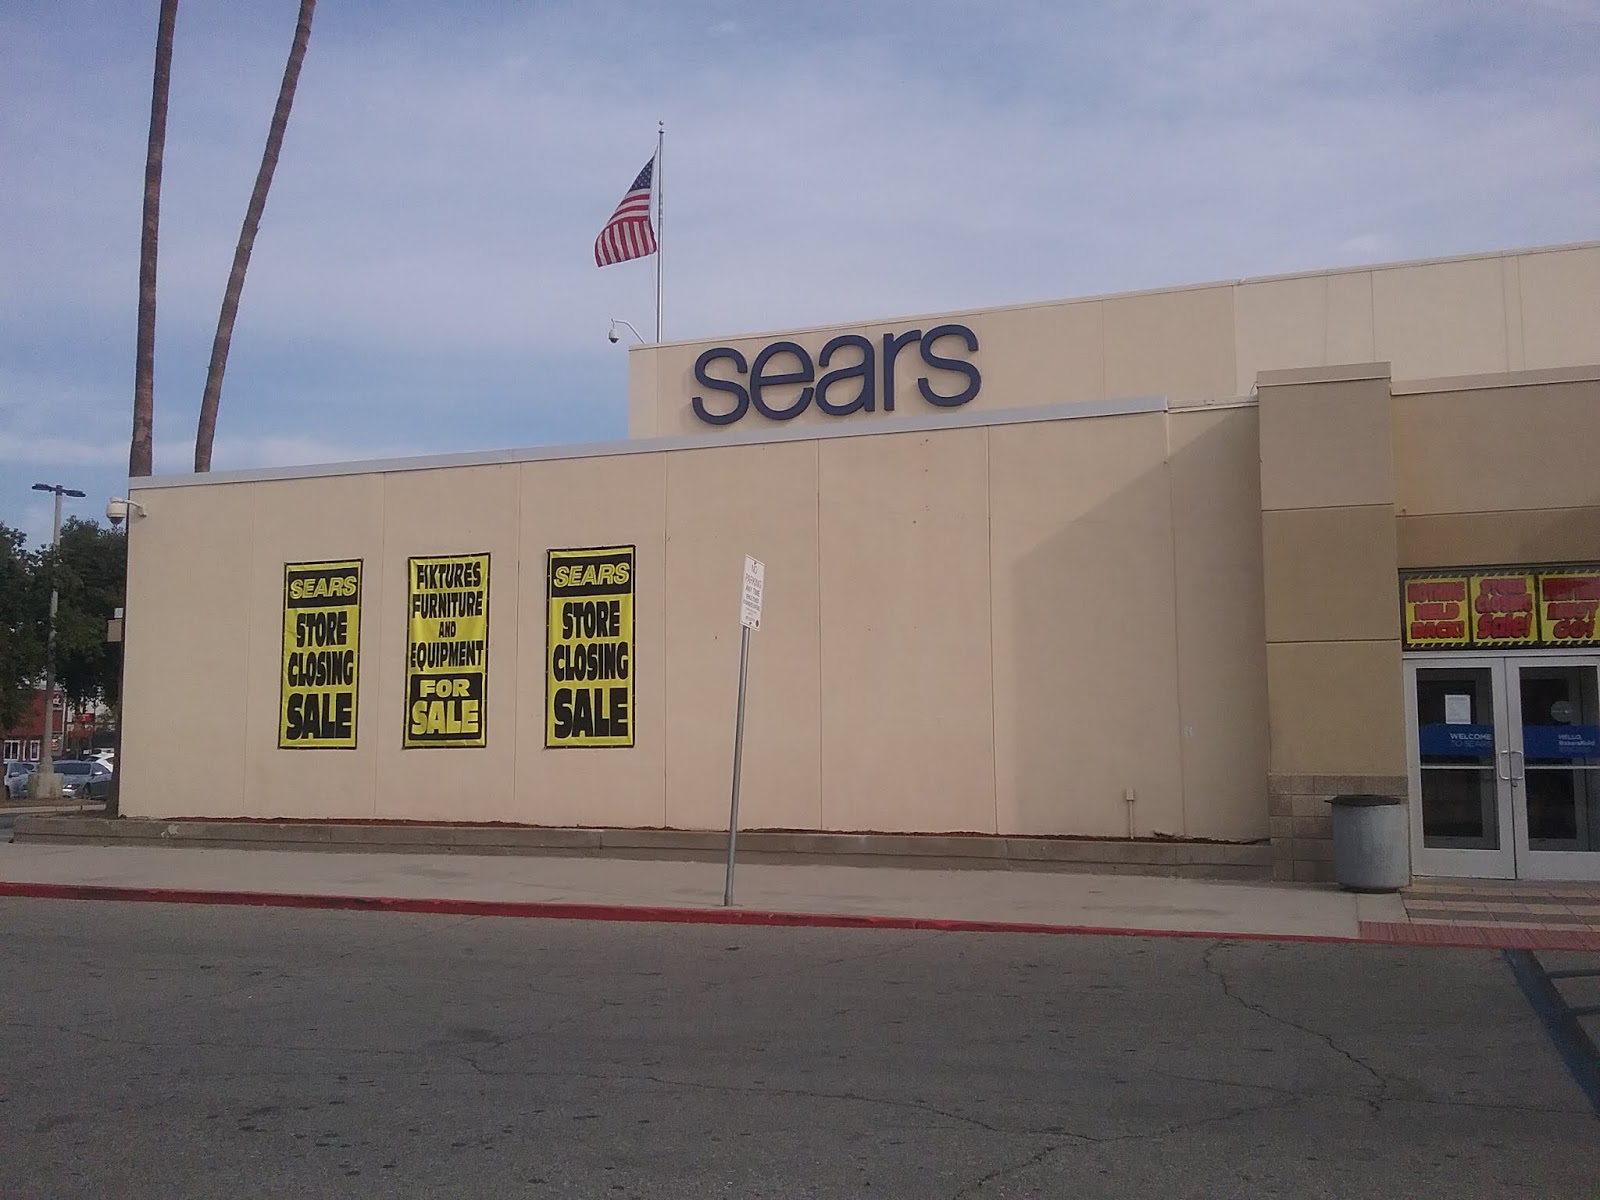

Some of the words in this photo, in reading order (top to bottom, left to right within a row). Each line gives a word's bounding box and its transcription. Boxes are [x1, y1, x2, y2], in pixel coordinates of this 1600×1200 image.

[692, 324, 981, 425] sears
[289, 575, 357, 600] SEARS
[416, 561, 481, 590] FIXTURES
[553, 563, 630, 587] SEARS
[412, 590, 484, 619] FURNITURE
[562, 600, 620, 640] STORE
[296, 610, 347, 647] STORE
[438, 620, 457, 638] AND
[287, 650, 354, 687] CLOSING
[410, 640, 484, 671] EQUIPMENT
[552, 641, 629, 682] CLOSING
[419, 679, 471, 698] FOR
[286, 692, 352, 740] SALE
[411, 699, 479, 735] SALE
[554, 687, 629, 739] SALE
